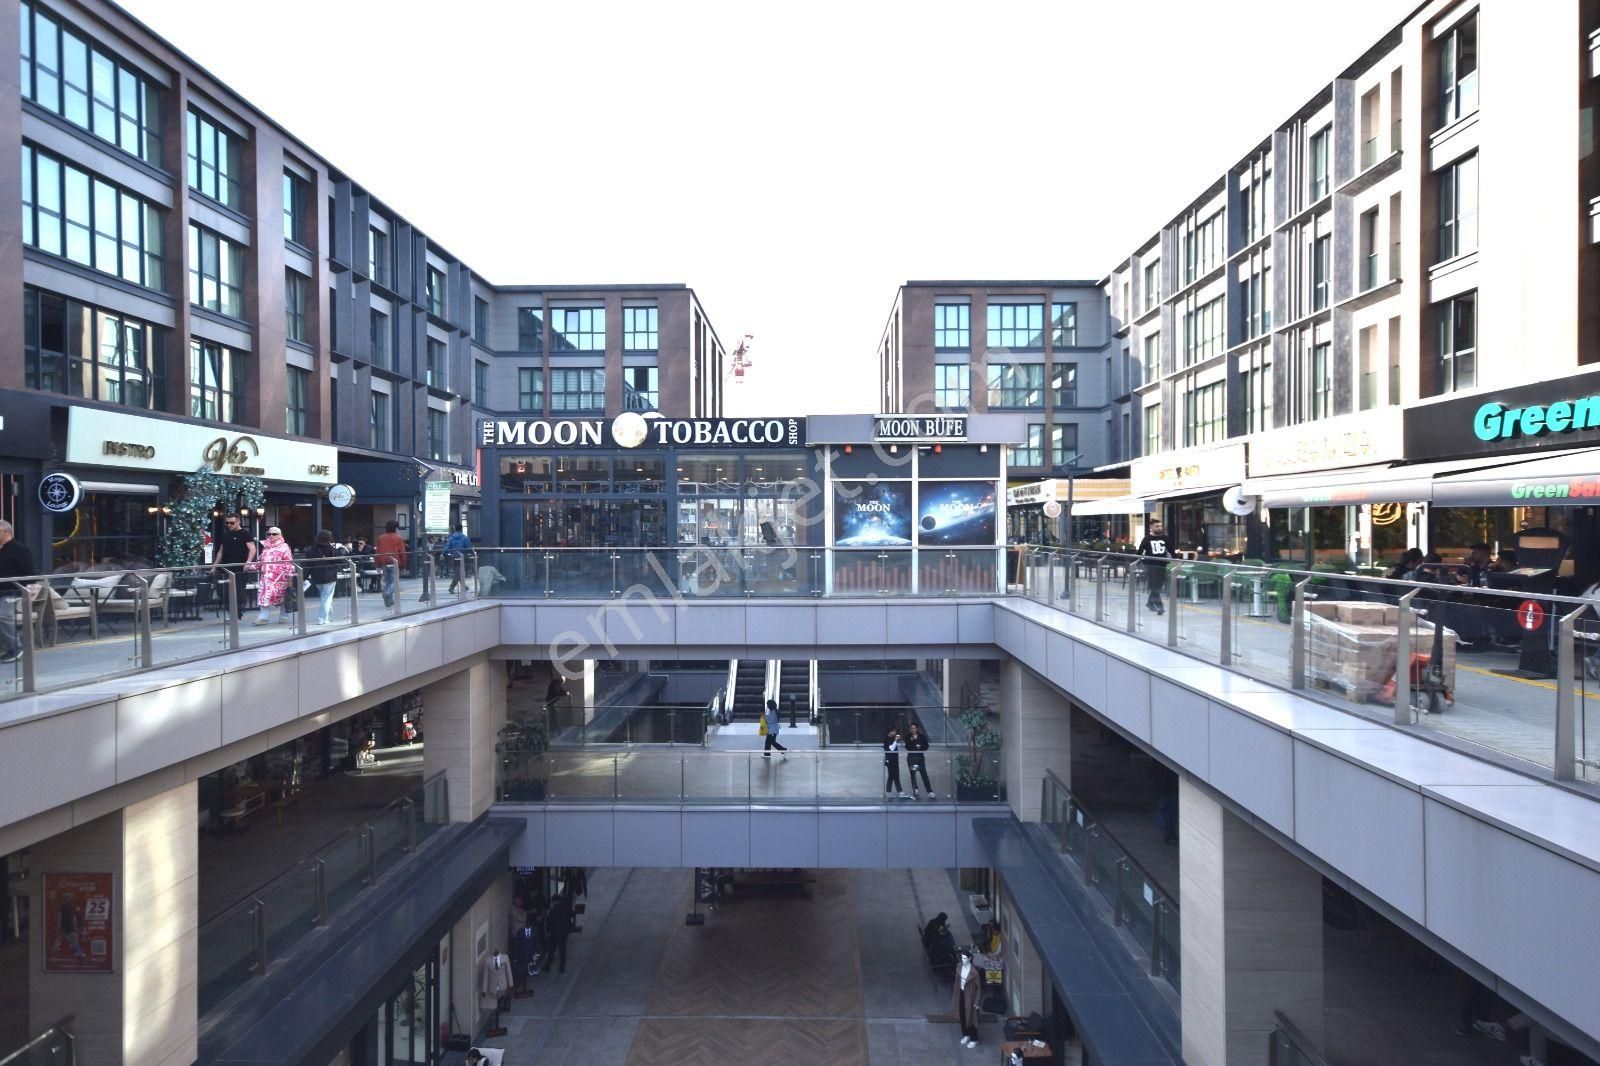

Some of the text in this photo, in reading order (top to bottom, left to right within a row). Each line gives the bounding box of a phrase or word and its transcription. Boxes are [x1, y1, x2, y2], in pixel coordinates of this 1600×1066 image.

[1474, 396, 1600, 441] Green
[483, 418, 798, 445] THE MOON TOBACCO SHOP
[879, 417, 963, 437] MOON BÜFE
[102, 440, 155, 459] BISTRO
[308, 464, 330, 477] CAFE
[455, 471, 469, 485] THE
[856, 503, 891, 513] MOON
[939, 503, 974, 513] MOON
[90, 901, 106, 914] 25
